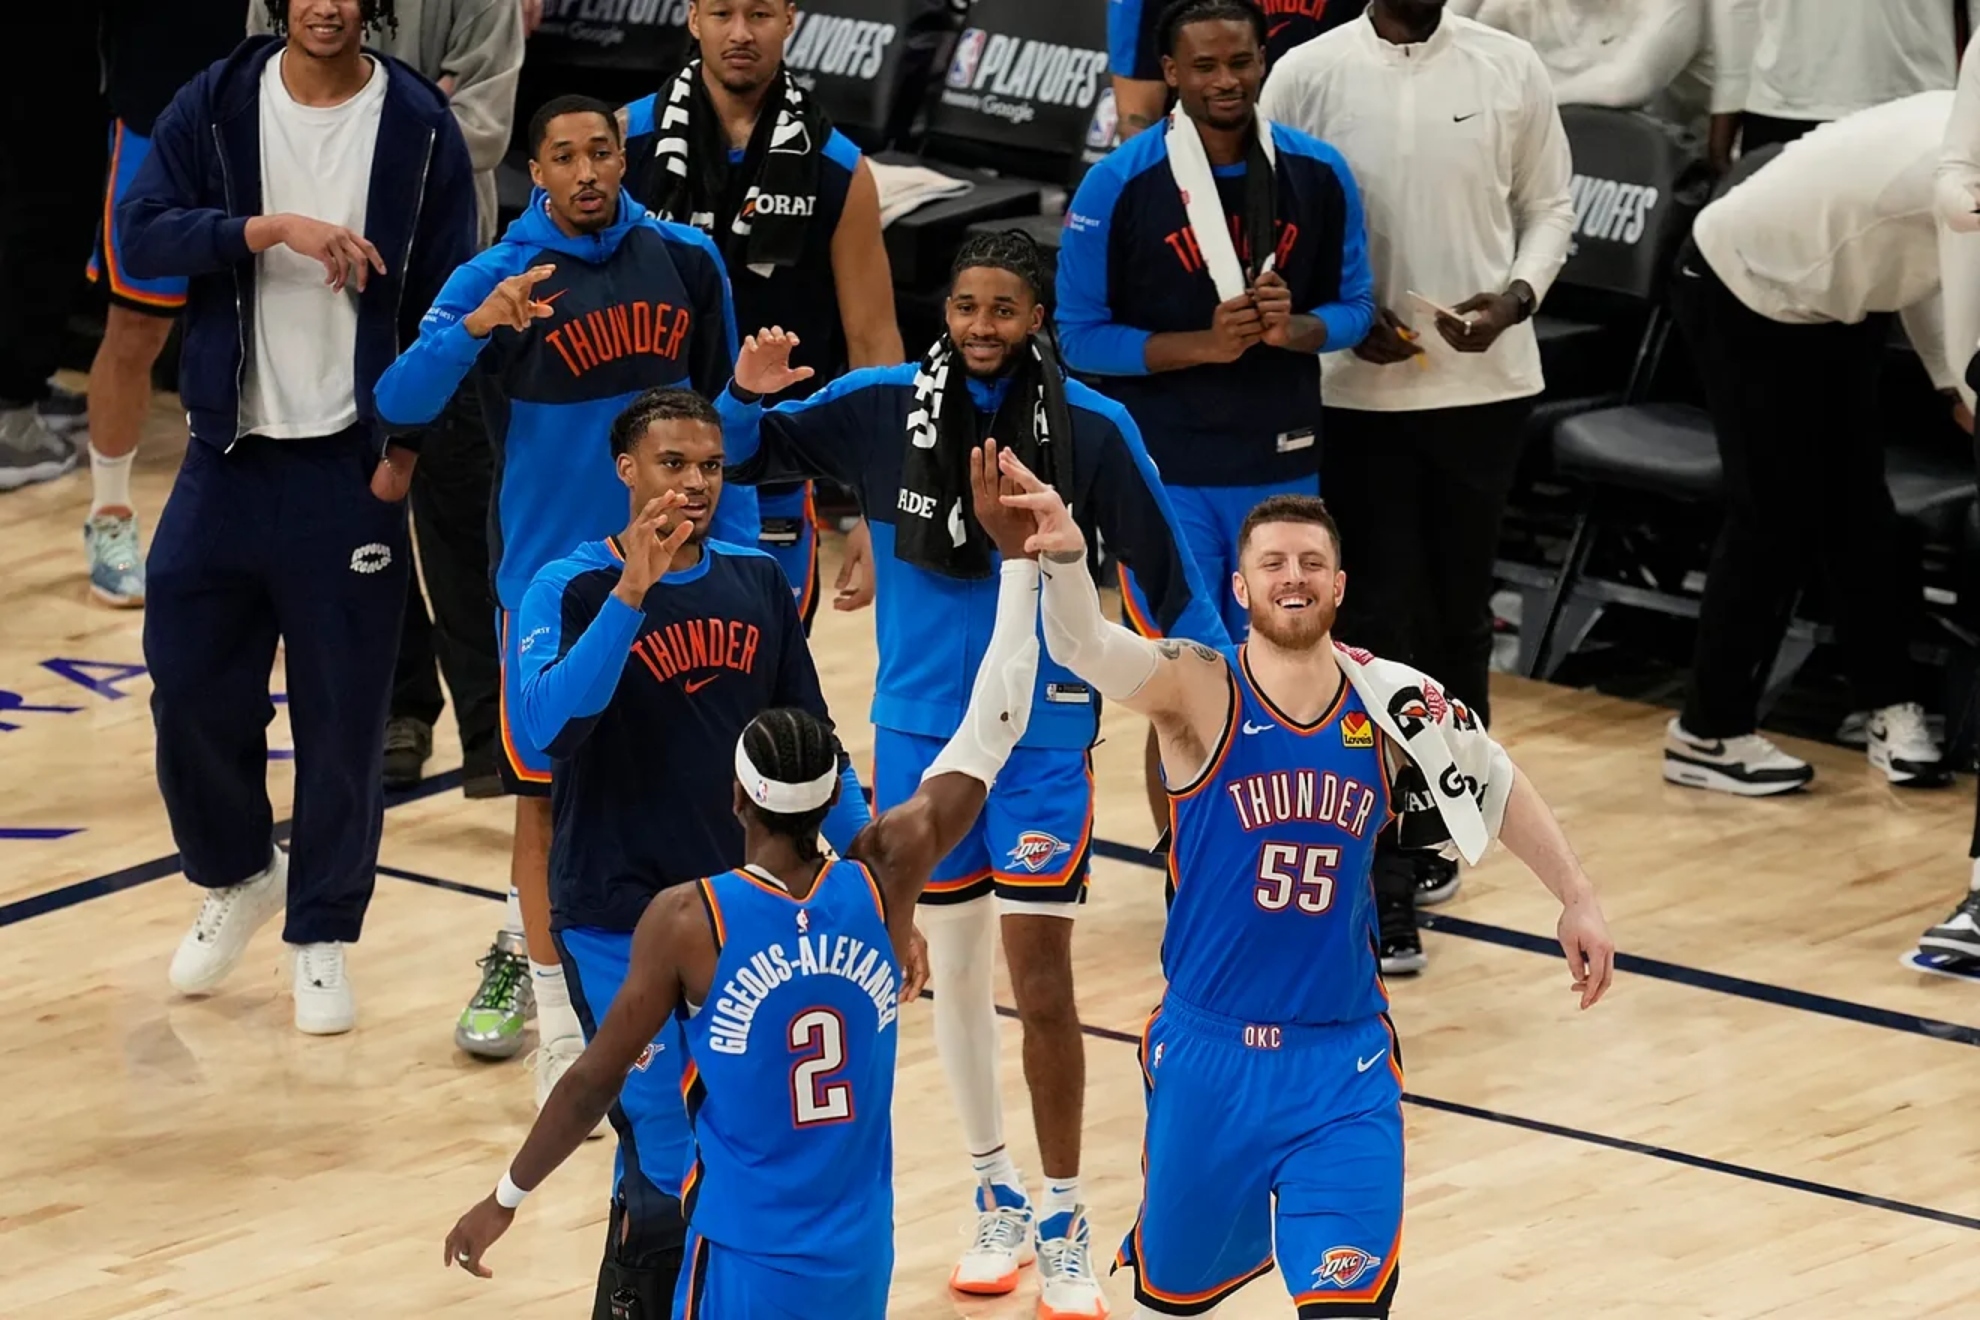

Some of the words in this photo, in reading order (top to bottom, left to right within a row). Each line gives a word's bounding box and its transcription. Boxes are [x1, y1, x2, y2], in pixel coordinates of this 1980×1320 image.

[972, 34, 1109, 109] PLAYOFFS
[545, 301, 690, 377] THUNDER
[897, 488, 937, 519] ADE
[630, 618, 760, 682] THUNDER
[1227, 770, 1376, 838] THUNDER
[1254, 841, 1342, 914] 55
[709, 934, 898, 1054] GILGEOUS-ALEXANDER
[788, 1006, 855, 1128] 2
[1244, 1025, 1281, 1048] OKC
